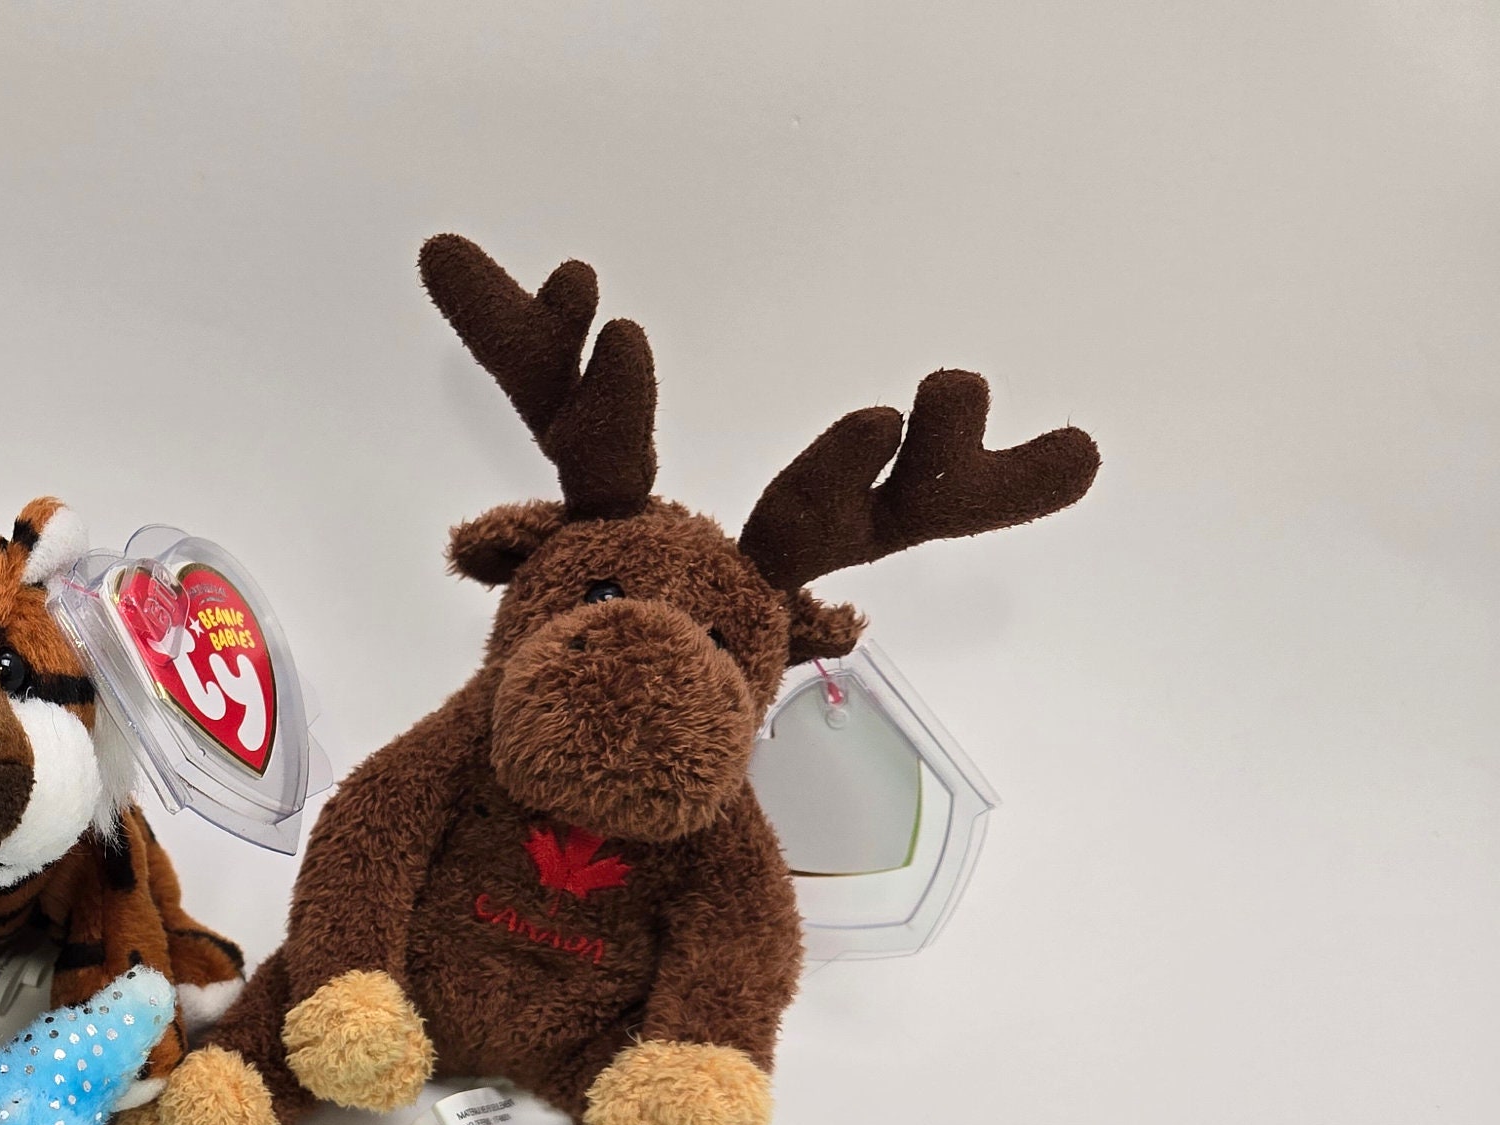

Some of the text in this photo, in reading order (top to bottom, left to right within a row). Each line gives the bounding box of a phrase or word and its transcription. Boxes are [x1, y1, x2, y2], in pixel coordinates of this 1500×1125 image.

[197, 606, 245, 630] BEANIE
[209, 627, 256, 651] BABIES
[474, 893, 605, 964] CANADA
